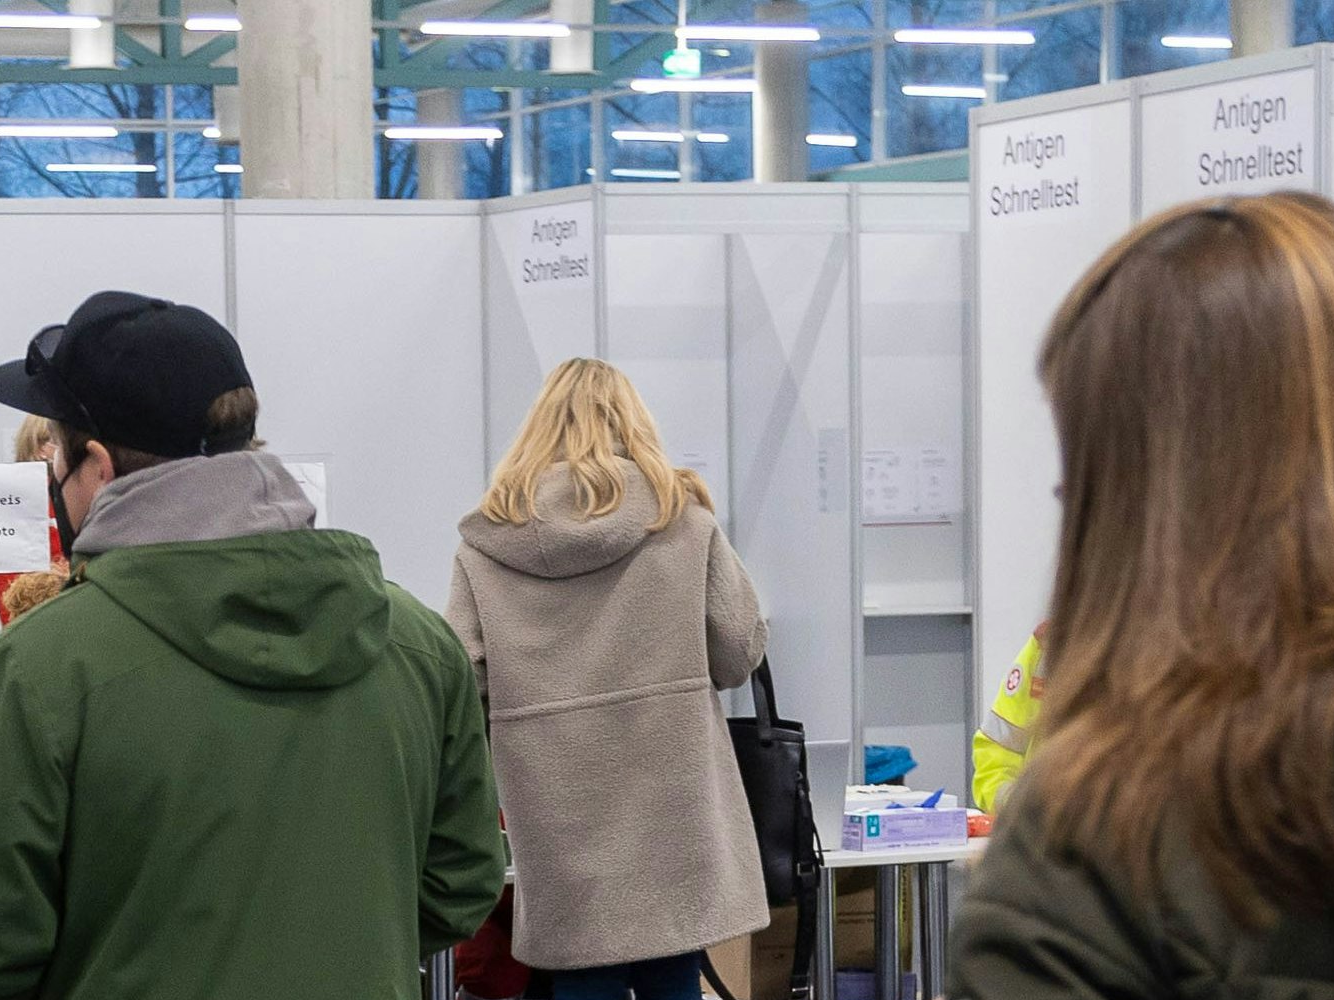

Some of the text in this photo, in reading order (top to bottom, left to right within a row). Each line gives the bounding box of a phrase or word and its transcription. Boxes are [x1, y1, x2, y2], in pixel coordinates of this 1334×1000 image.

[1214, 95, 1287, 135] Antigen
[1002, 132, 1065, 169] Antigen
[1198, 142, 1303, 186] Schnelltest
[989, 176, 1080, 216] Schnelltest
[531, 218, 578, 247] Antigen
[523, 253, 589, 283] Schnelltest
